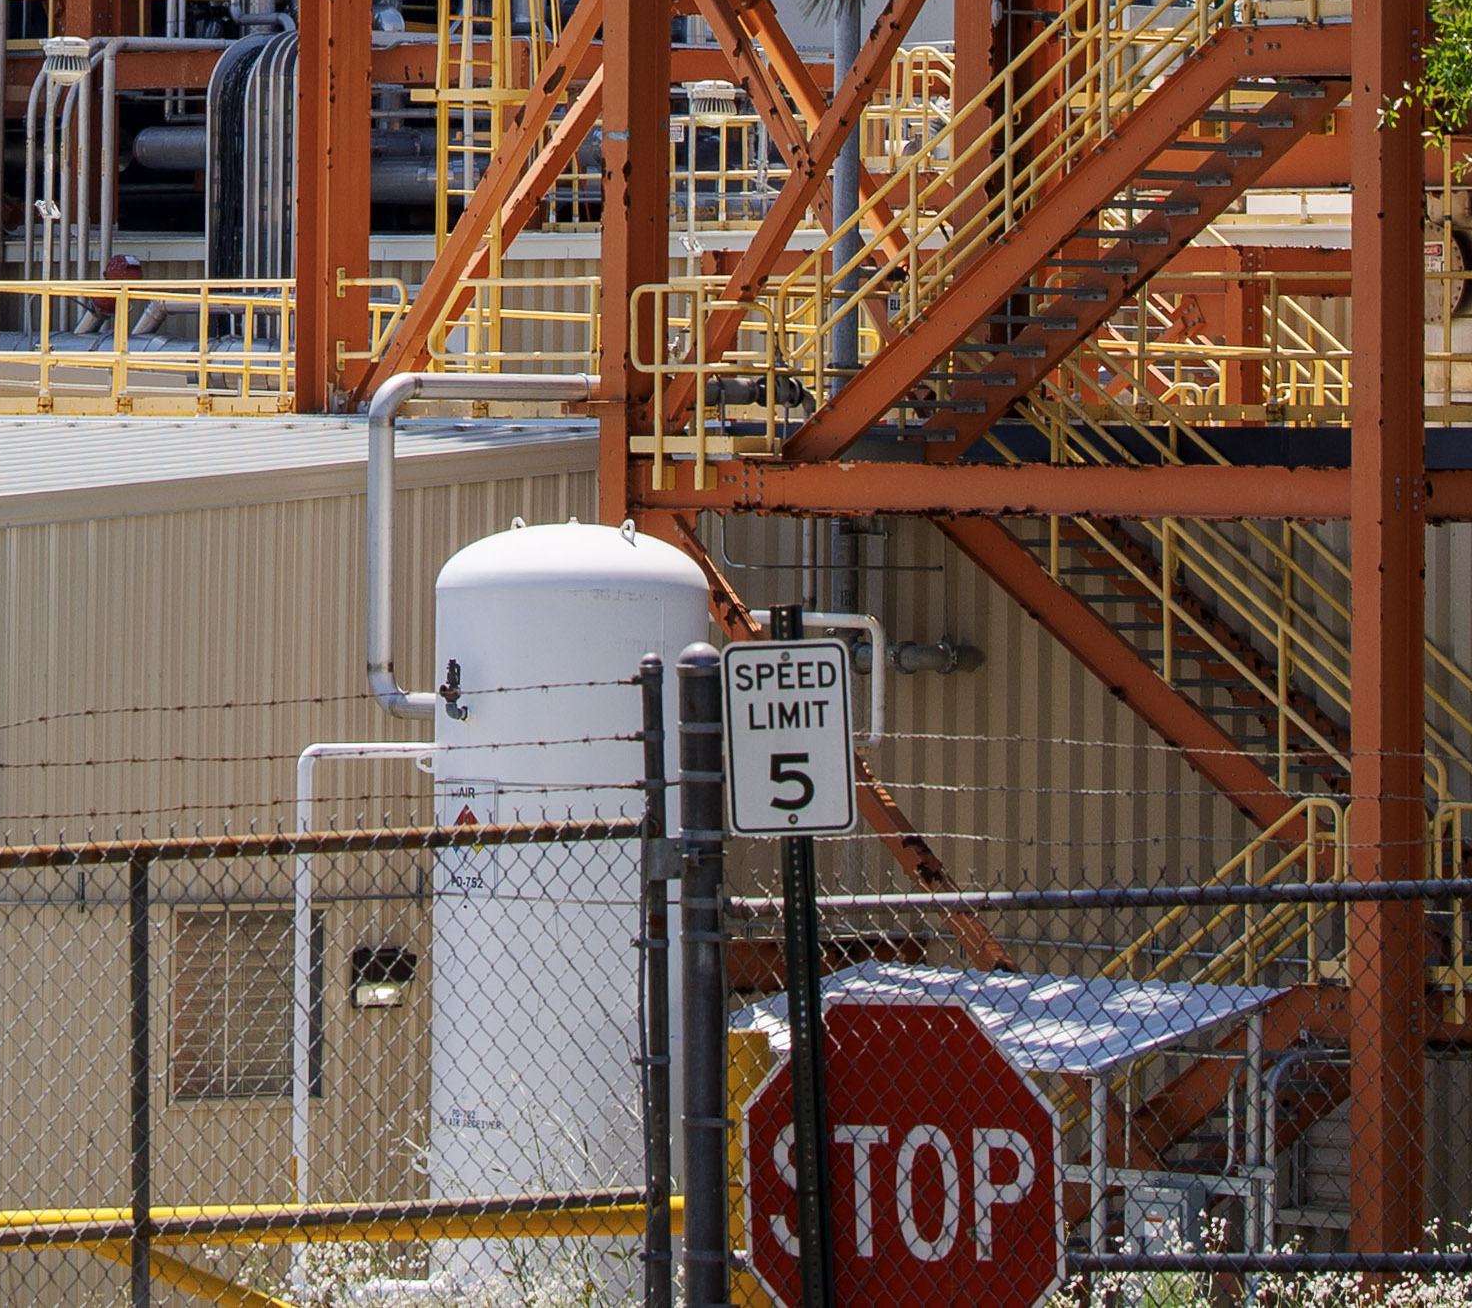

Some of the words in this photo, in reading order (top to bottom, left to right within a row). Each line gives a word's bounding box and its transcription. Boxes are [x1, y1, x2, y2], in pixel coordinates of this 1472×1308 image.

[735, 661, 837, 691] SPEED
[748, 700, 829, 730] LIMIT
[458, 786, 476, 799] AIR
[769, 752, 815, 811] 5
[769, 1123, 1036, 1263] STOP
